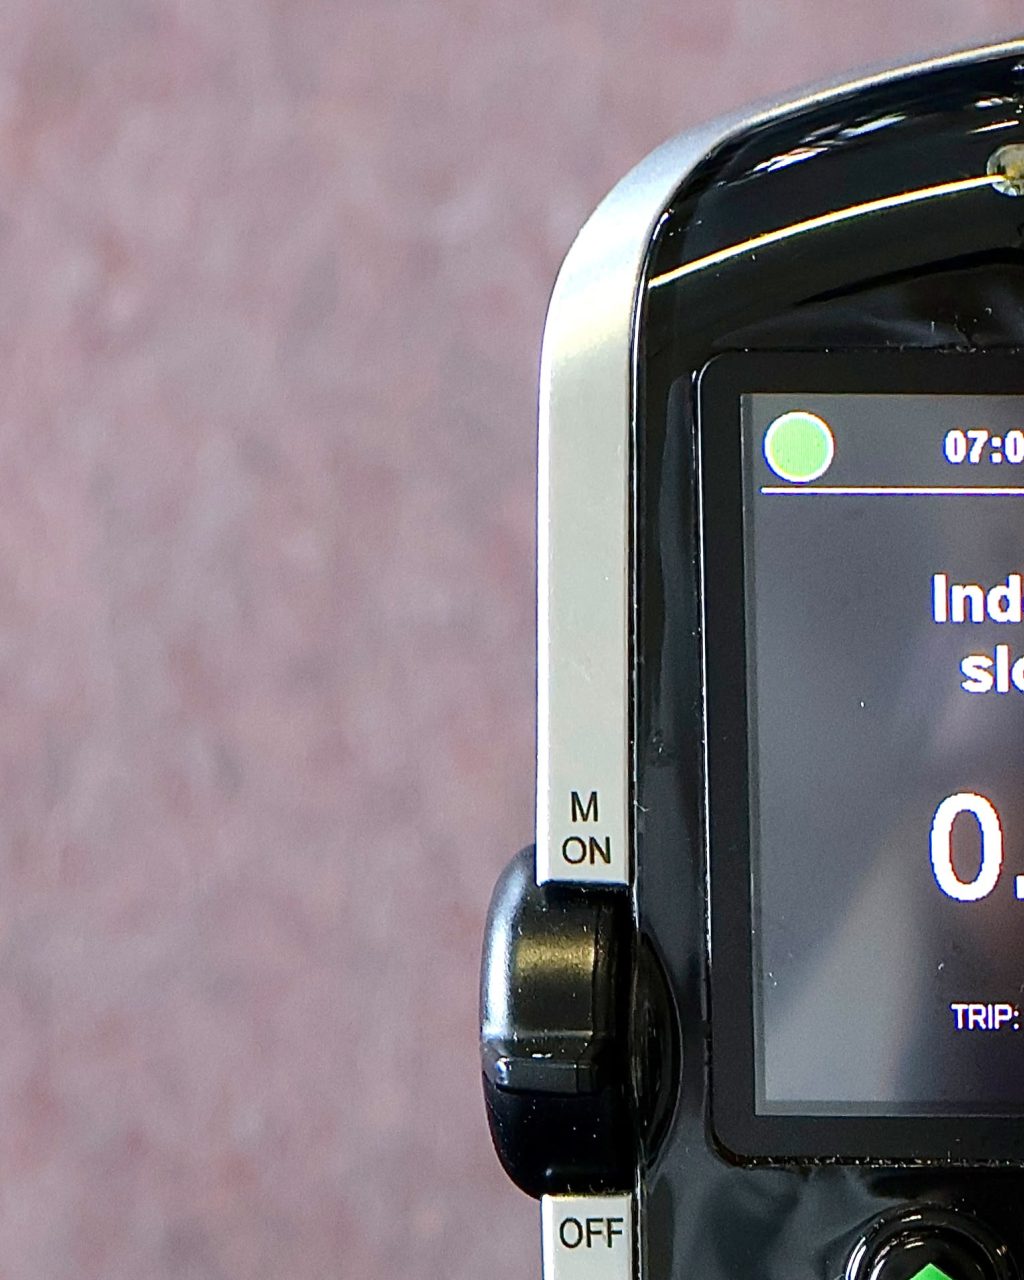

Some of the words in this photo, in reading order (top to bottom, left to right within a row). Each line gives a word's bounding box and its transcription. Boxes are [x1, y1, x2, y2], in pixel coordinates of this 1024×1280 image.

[570, 791, 599, 822] M
[561, 836, 611, 864] ON
[950, 1003, 1020, 1031] TRIP:
[558, 1217, 624, 1249] OFF
